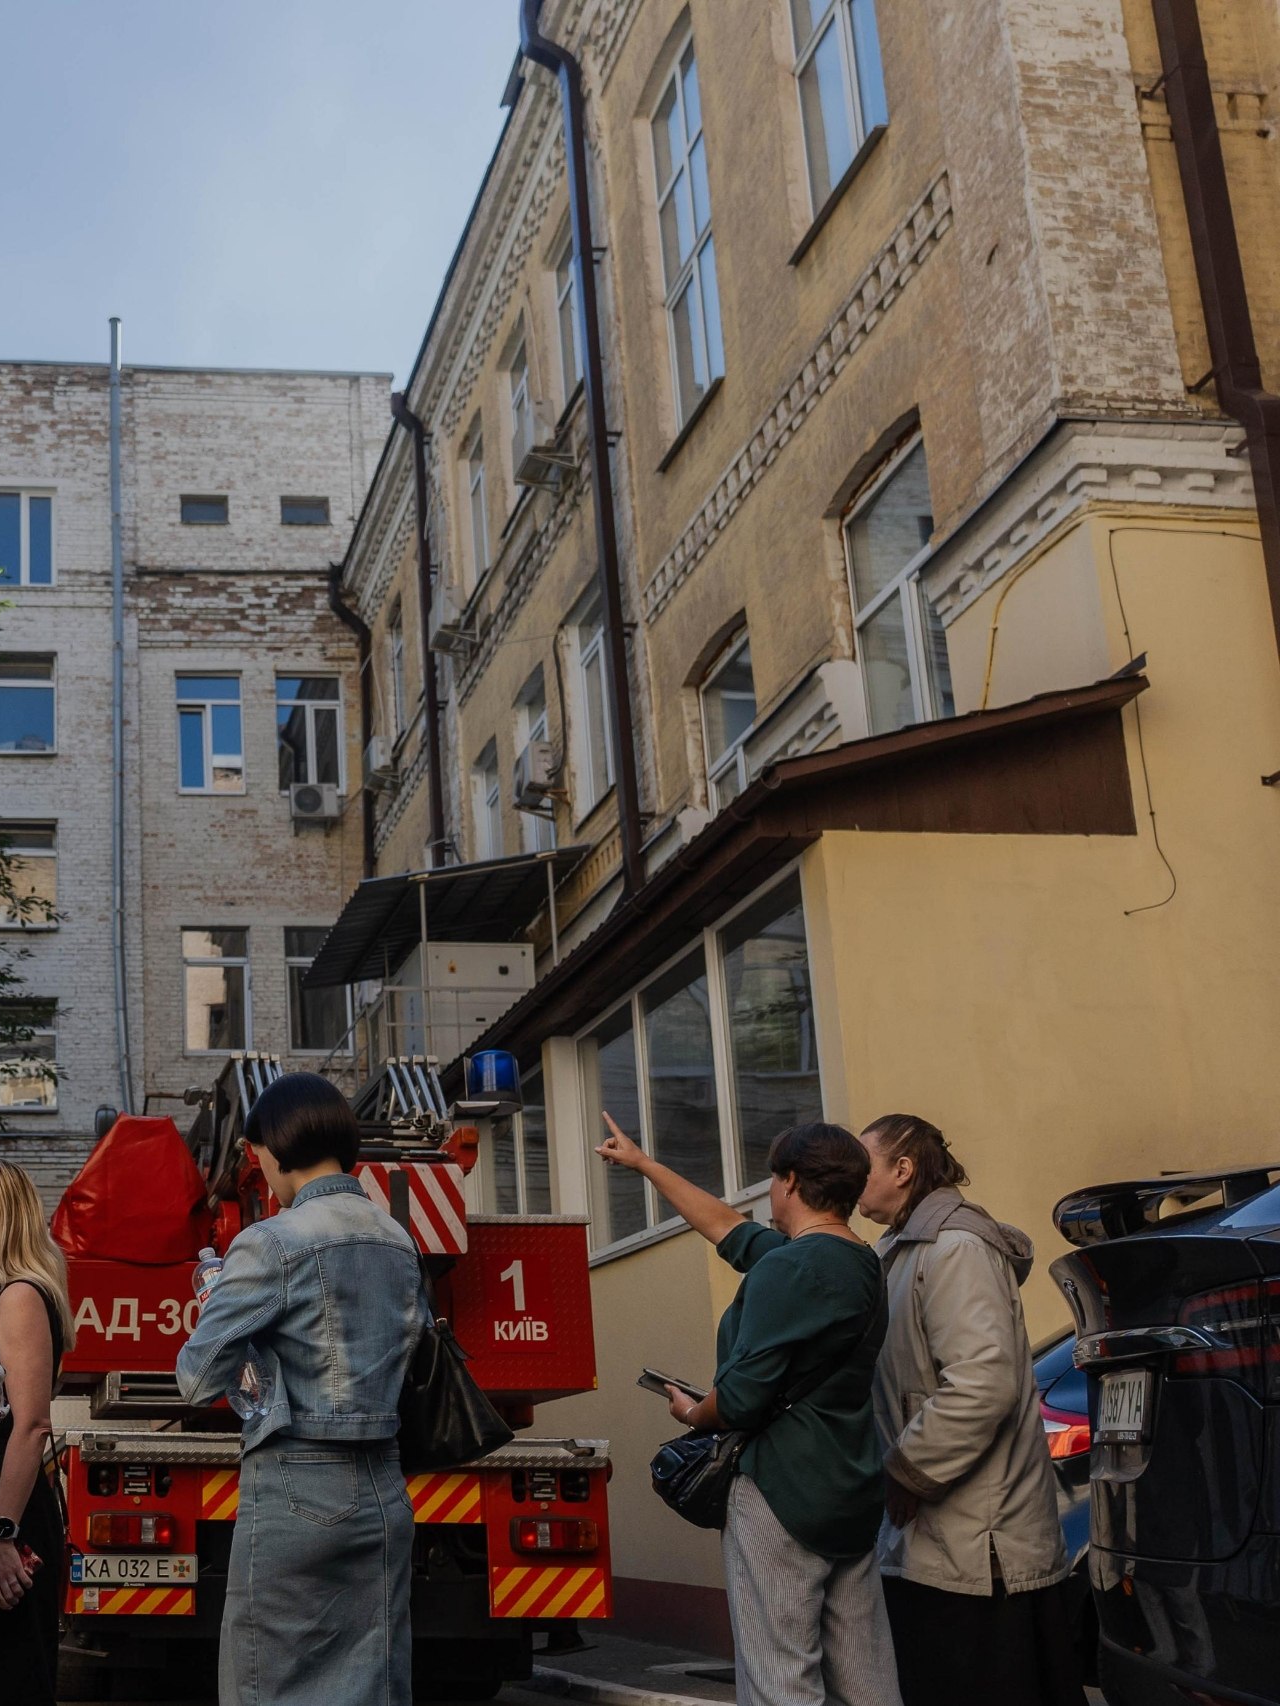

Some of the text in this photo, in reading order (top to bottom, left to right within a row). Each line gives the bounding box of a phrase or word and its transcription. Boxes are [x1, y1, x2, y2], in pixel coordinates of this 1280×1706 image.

[500, 1259, 526, 1312] 1
[494, 1316, 549, 1341] КИЇВ
[84, 1559, 170, 1578] KA 032 E
